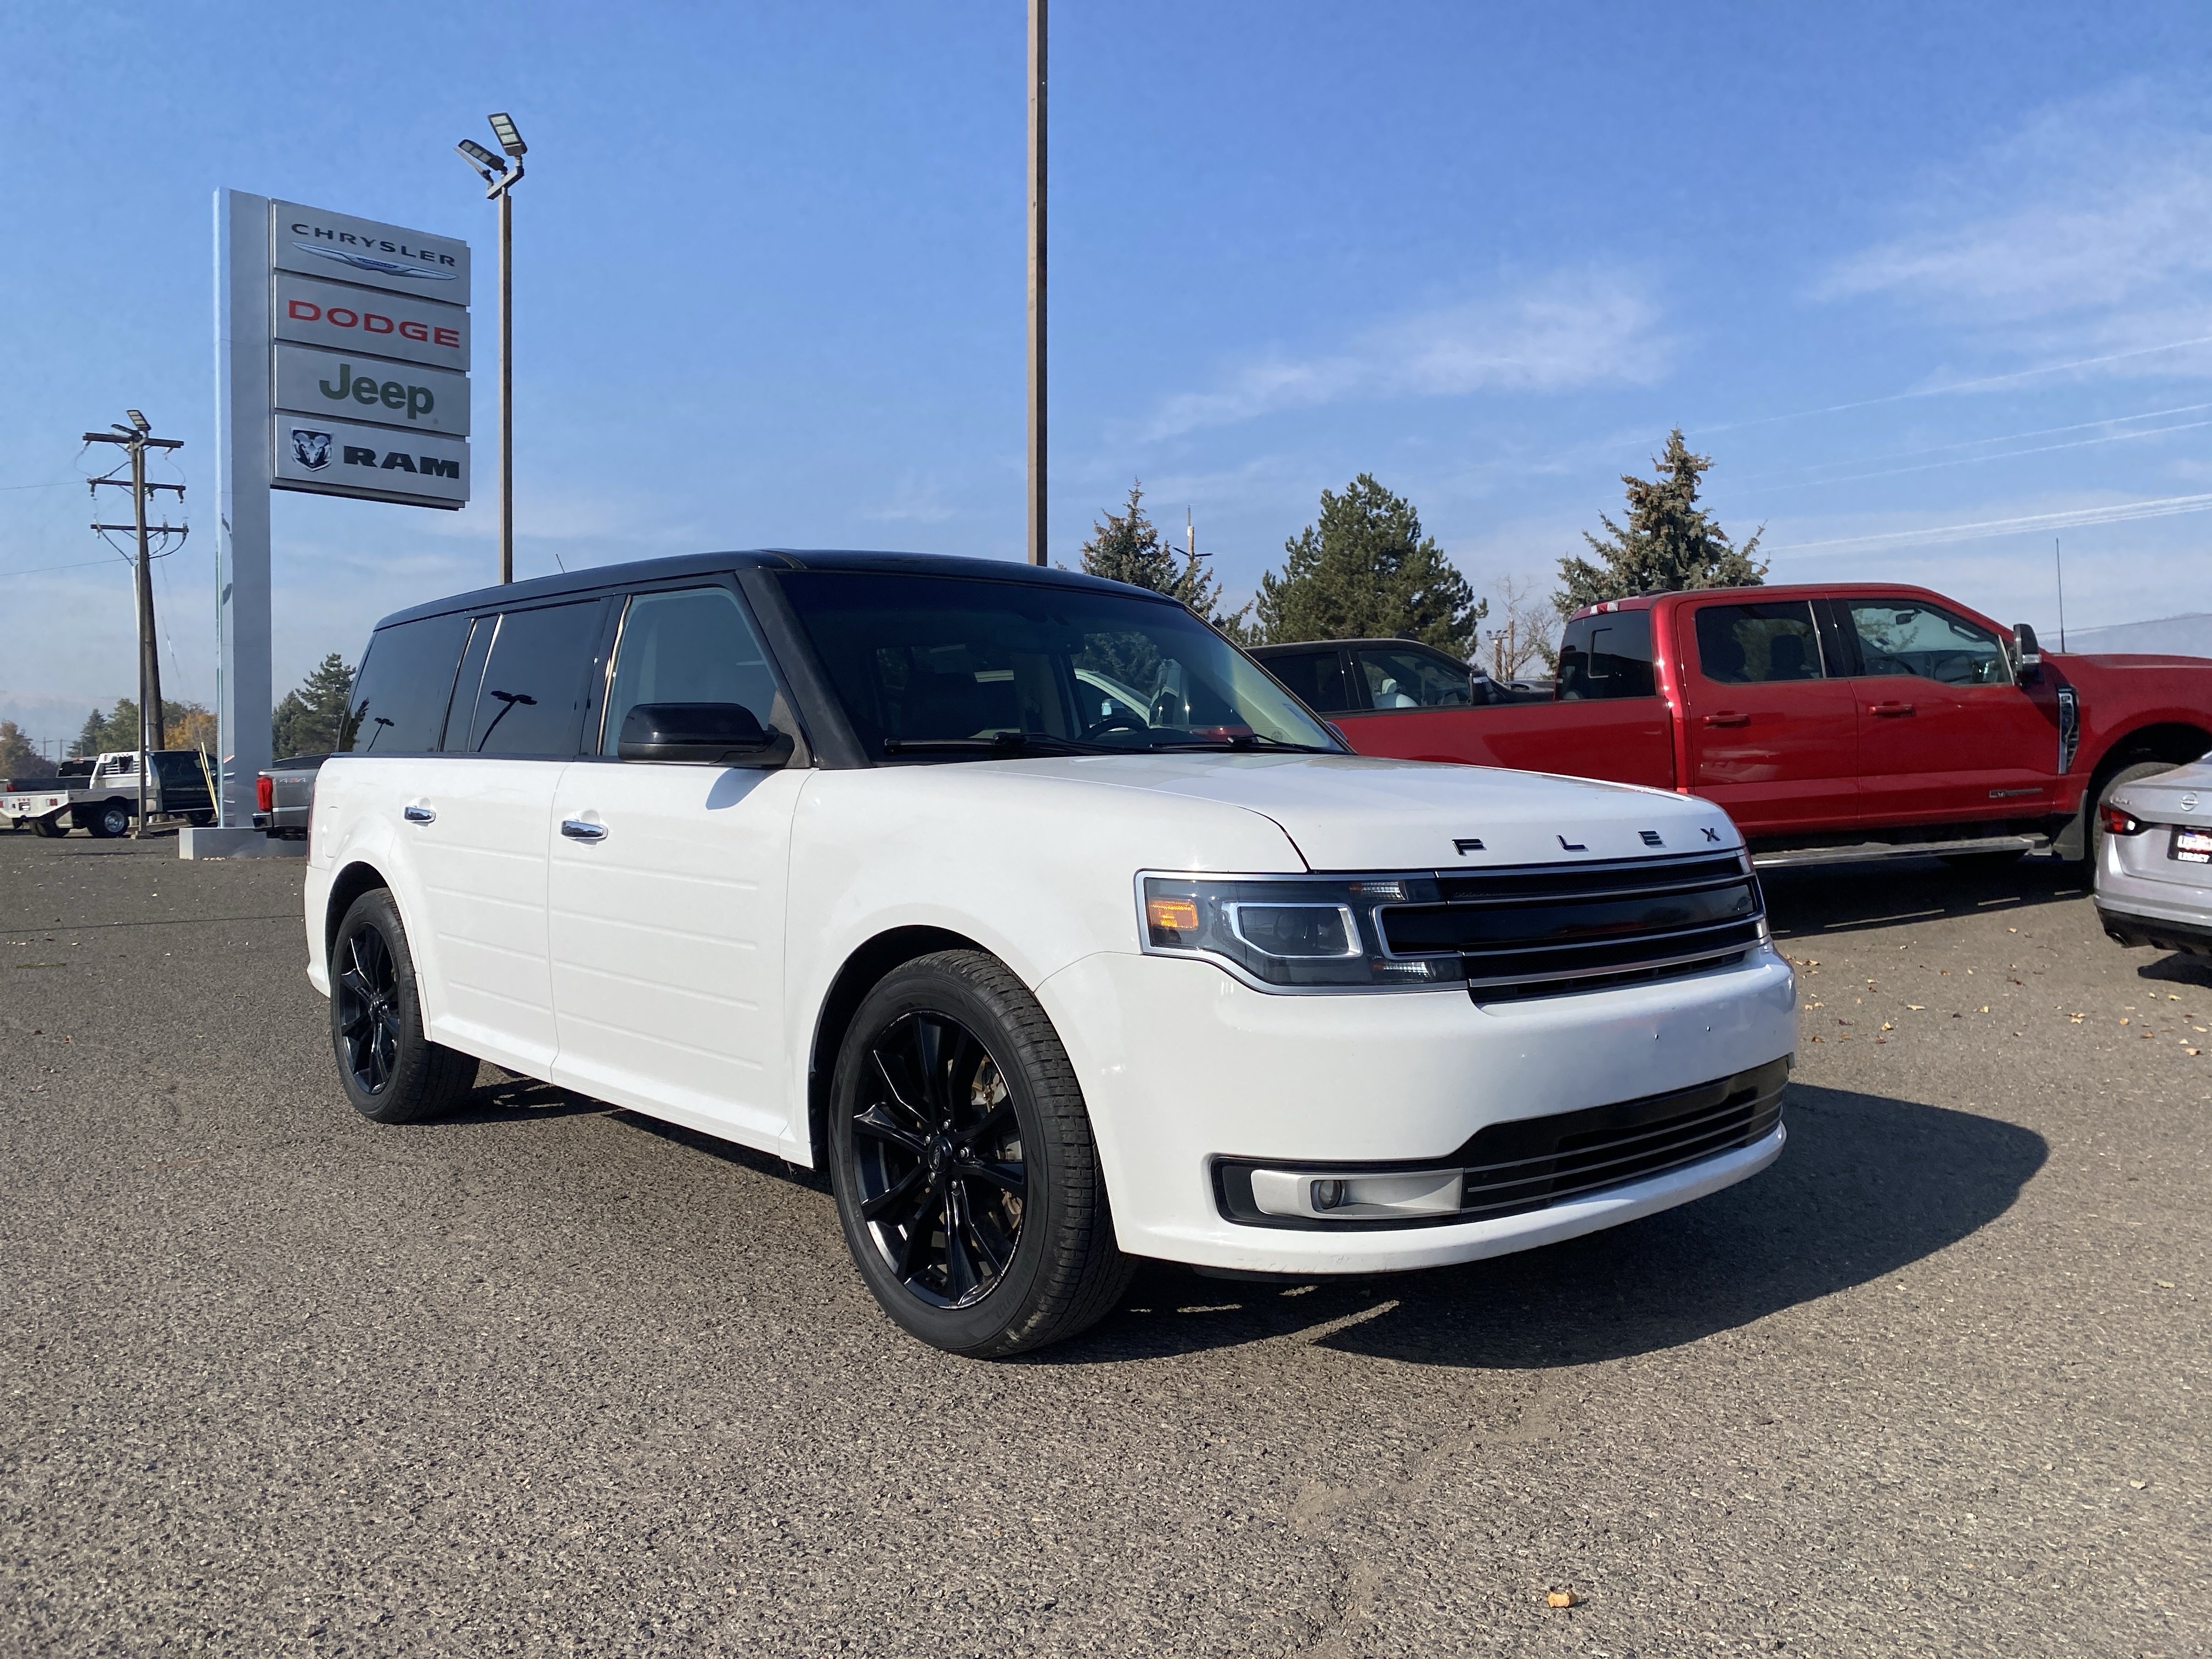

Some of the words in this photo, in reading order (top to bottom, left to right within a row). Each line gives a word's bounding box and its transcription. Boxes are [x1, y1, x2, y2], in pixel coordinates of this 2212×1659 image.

[291, 223, 455, 267] CHRYSLER
[288, 300, 460, 348] DODGE
[319, 363, 435, 420] Jeep
[343, 445, 459, 479] RAM
[1451, 827, 1721, 856] FLEX
